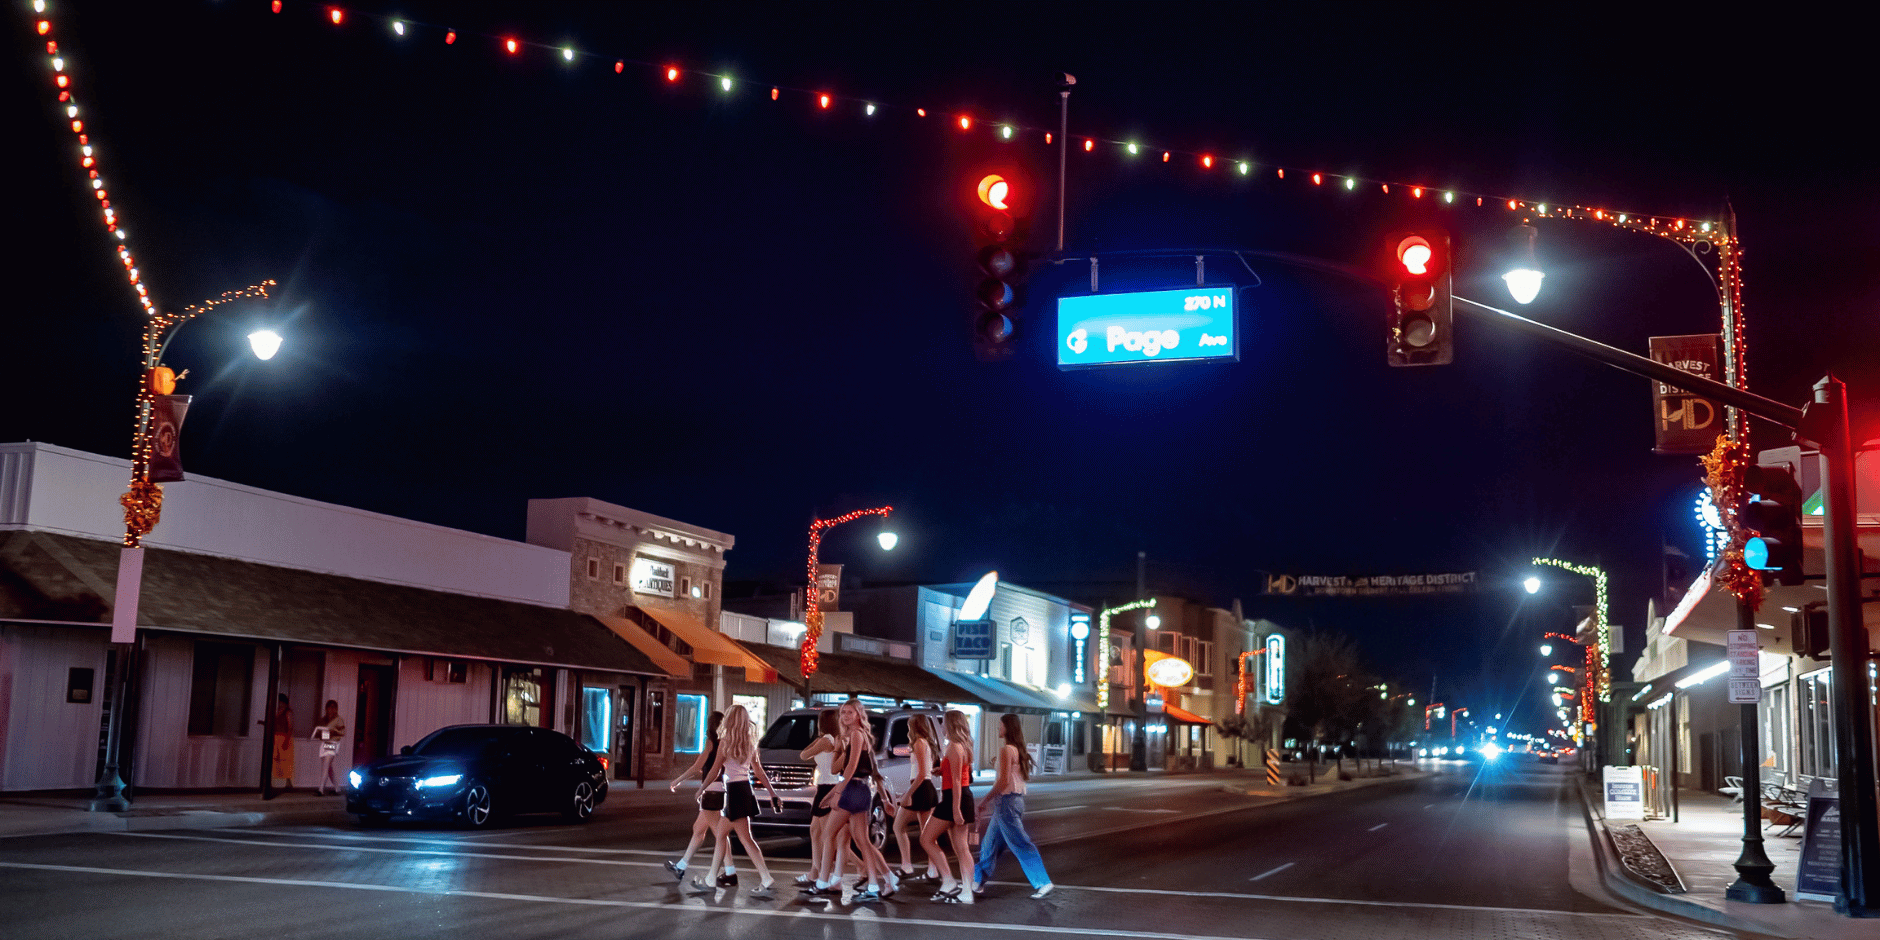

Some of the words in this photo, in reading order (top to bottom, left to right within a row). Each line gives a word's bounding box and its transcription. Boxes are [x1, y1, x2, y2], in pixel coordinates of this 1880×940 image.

[1184, 295, 1211, 310] 270
[1213, 295, 1226, 308] N
[1106, 325, 1180, 357] Page
[1198, 333, 1228, 347] Ave
[1667, 360, 1711, 373] ARVEST
[1298, 576, 1347, 587] HARVEST
[1370, 575, 1424, 586] HERITAGE
[1426, 572, 1475, 584] DISTRICT
[958, 624, 989, 635] FISH
[956, 637, 991, 649] TACO
